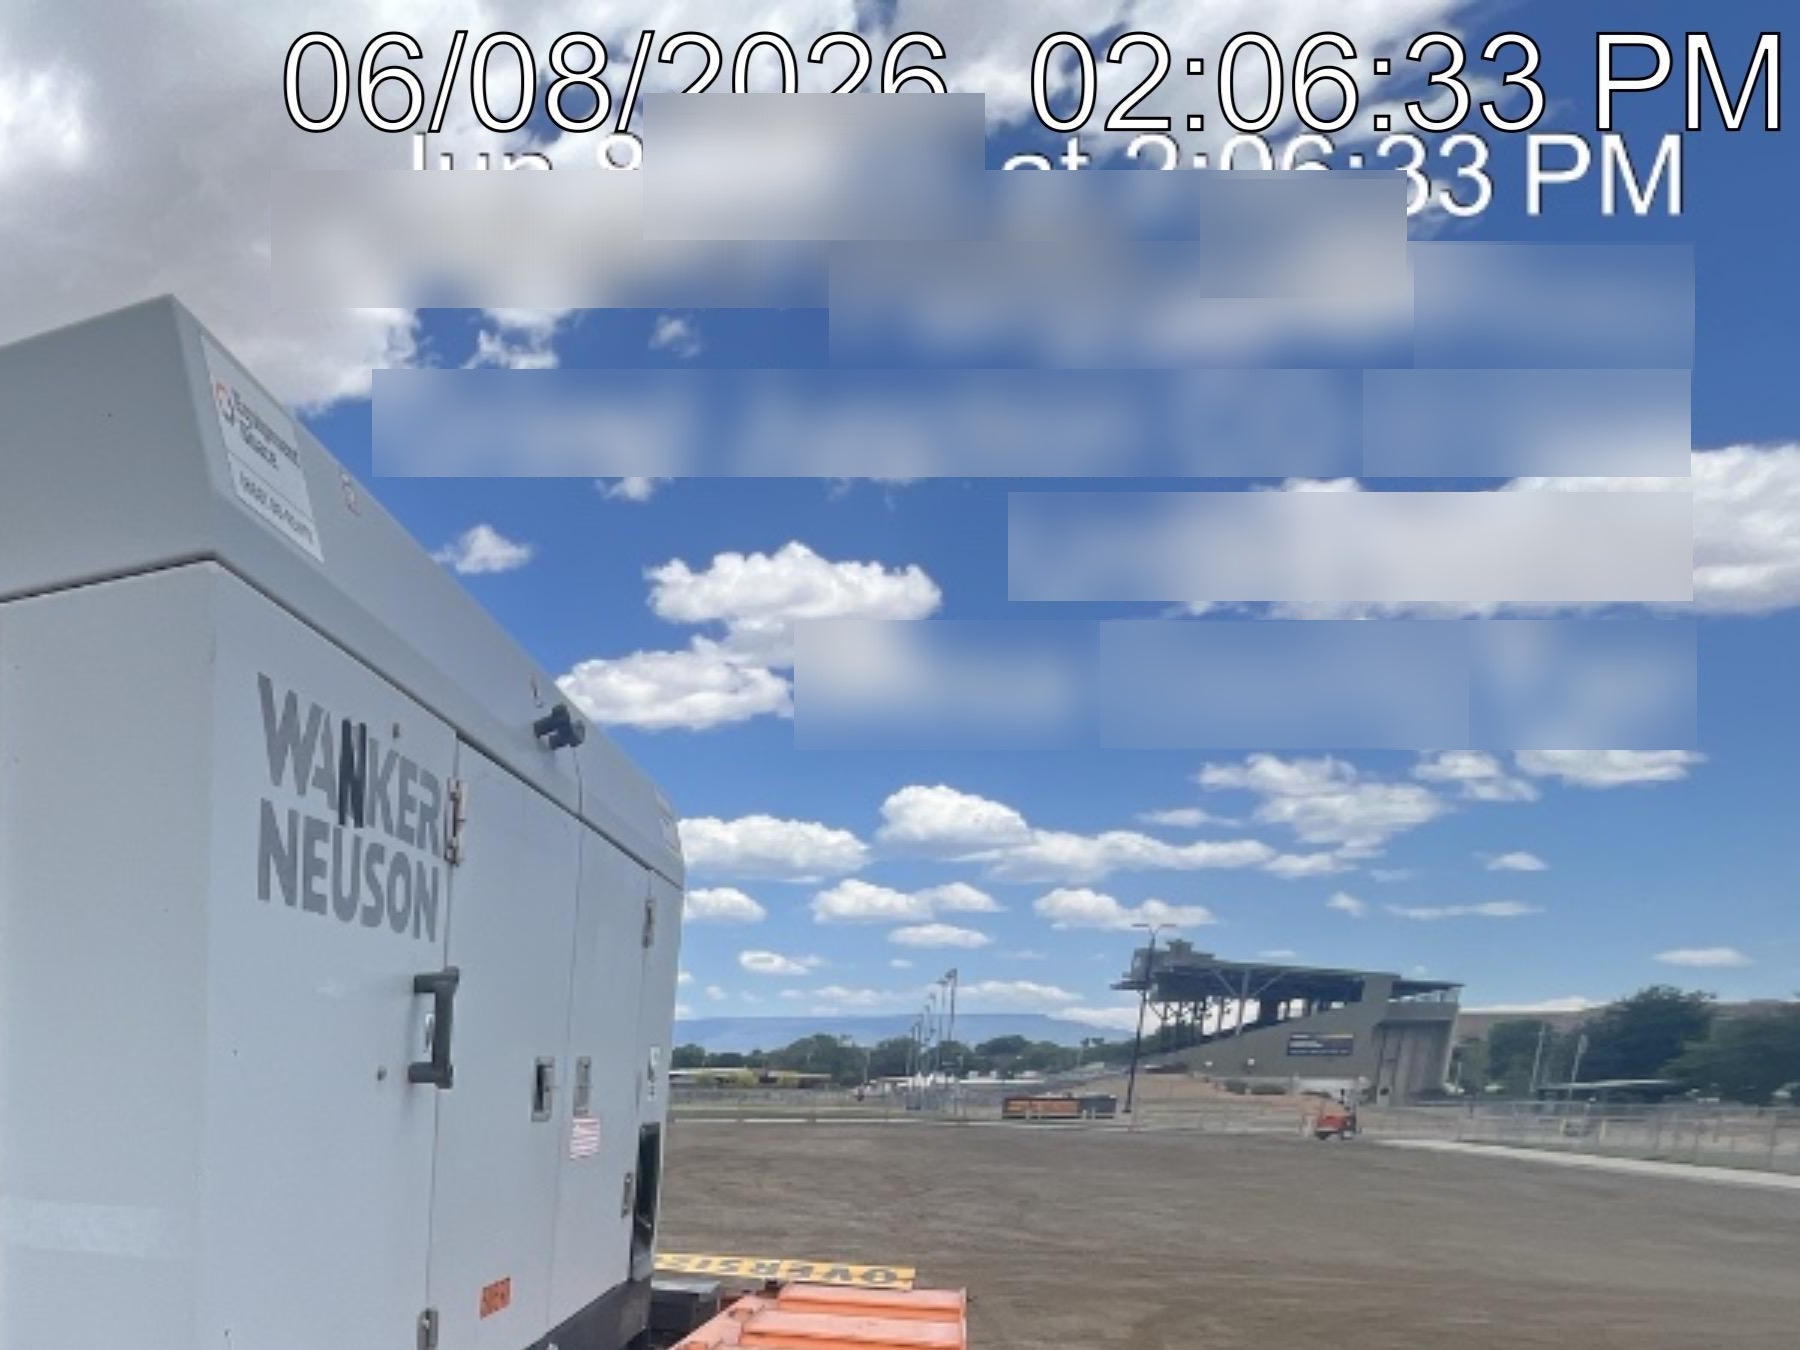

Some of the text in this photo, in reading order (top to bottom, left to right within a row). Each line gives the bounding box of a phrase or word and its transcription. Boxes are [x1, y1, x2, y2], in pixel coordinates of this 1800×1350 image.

[257, 671, 442, 858] WANKER
[257, 797, 439, 944] NEUSON
[654, 1253, 899, 1284] OVERSIZ
